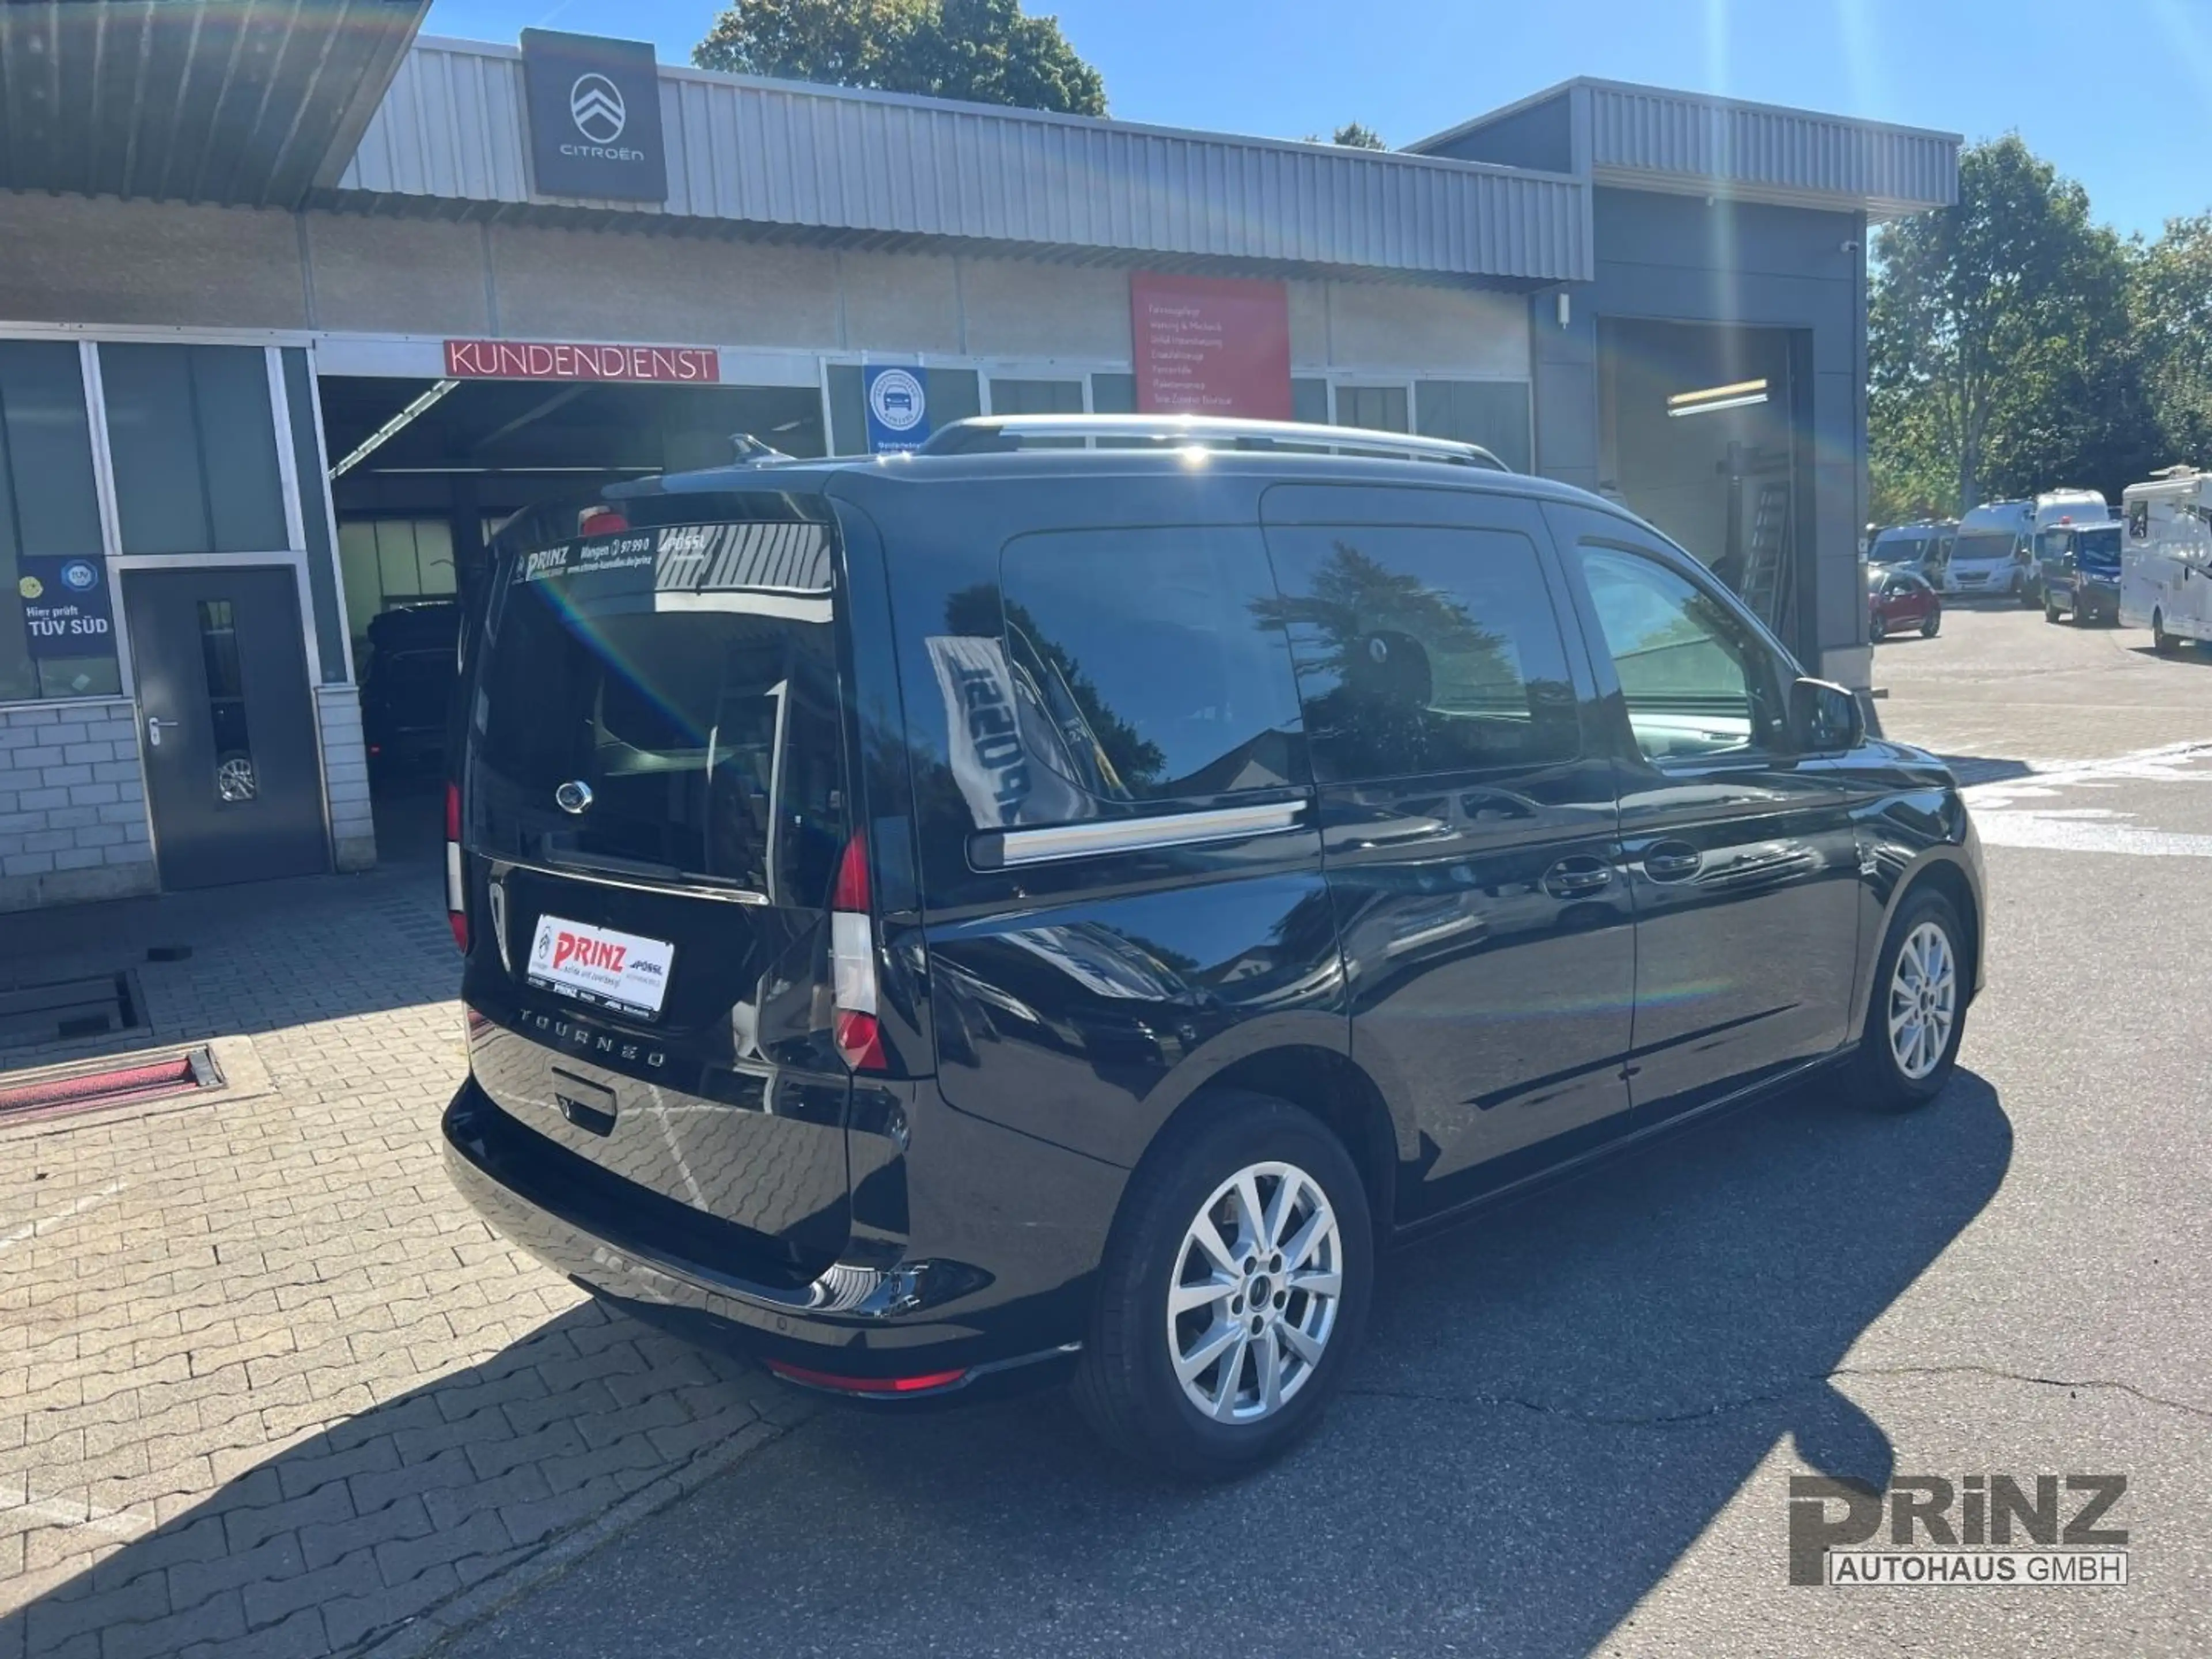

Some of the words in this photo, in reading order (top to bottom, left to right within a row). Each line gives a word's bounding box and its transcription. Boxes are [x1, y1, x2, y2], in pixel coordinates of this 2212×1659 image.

[451, 342, 713, 379] KUNDENDIENST
[525, 546, 569, 582] PRINZ
[26, 606, 50, 617] Hier
[28, 617, 66, 637] TÜV
[70, 615, 109, 634] SÜD
[552, 931, 627, 974] PRINZ
